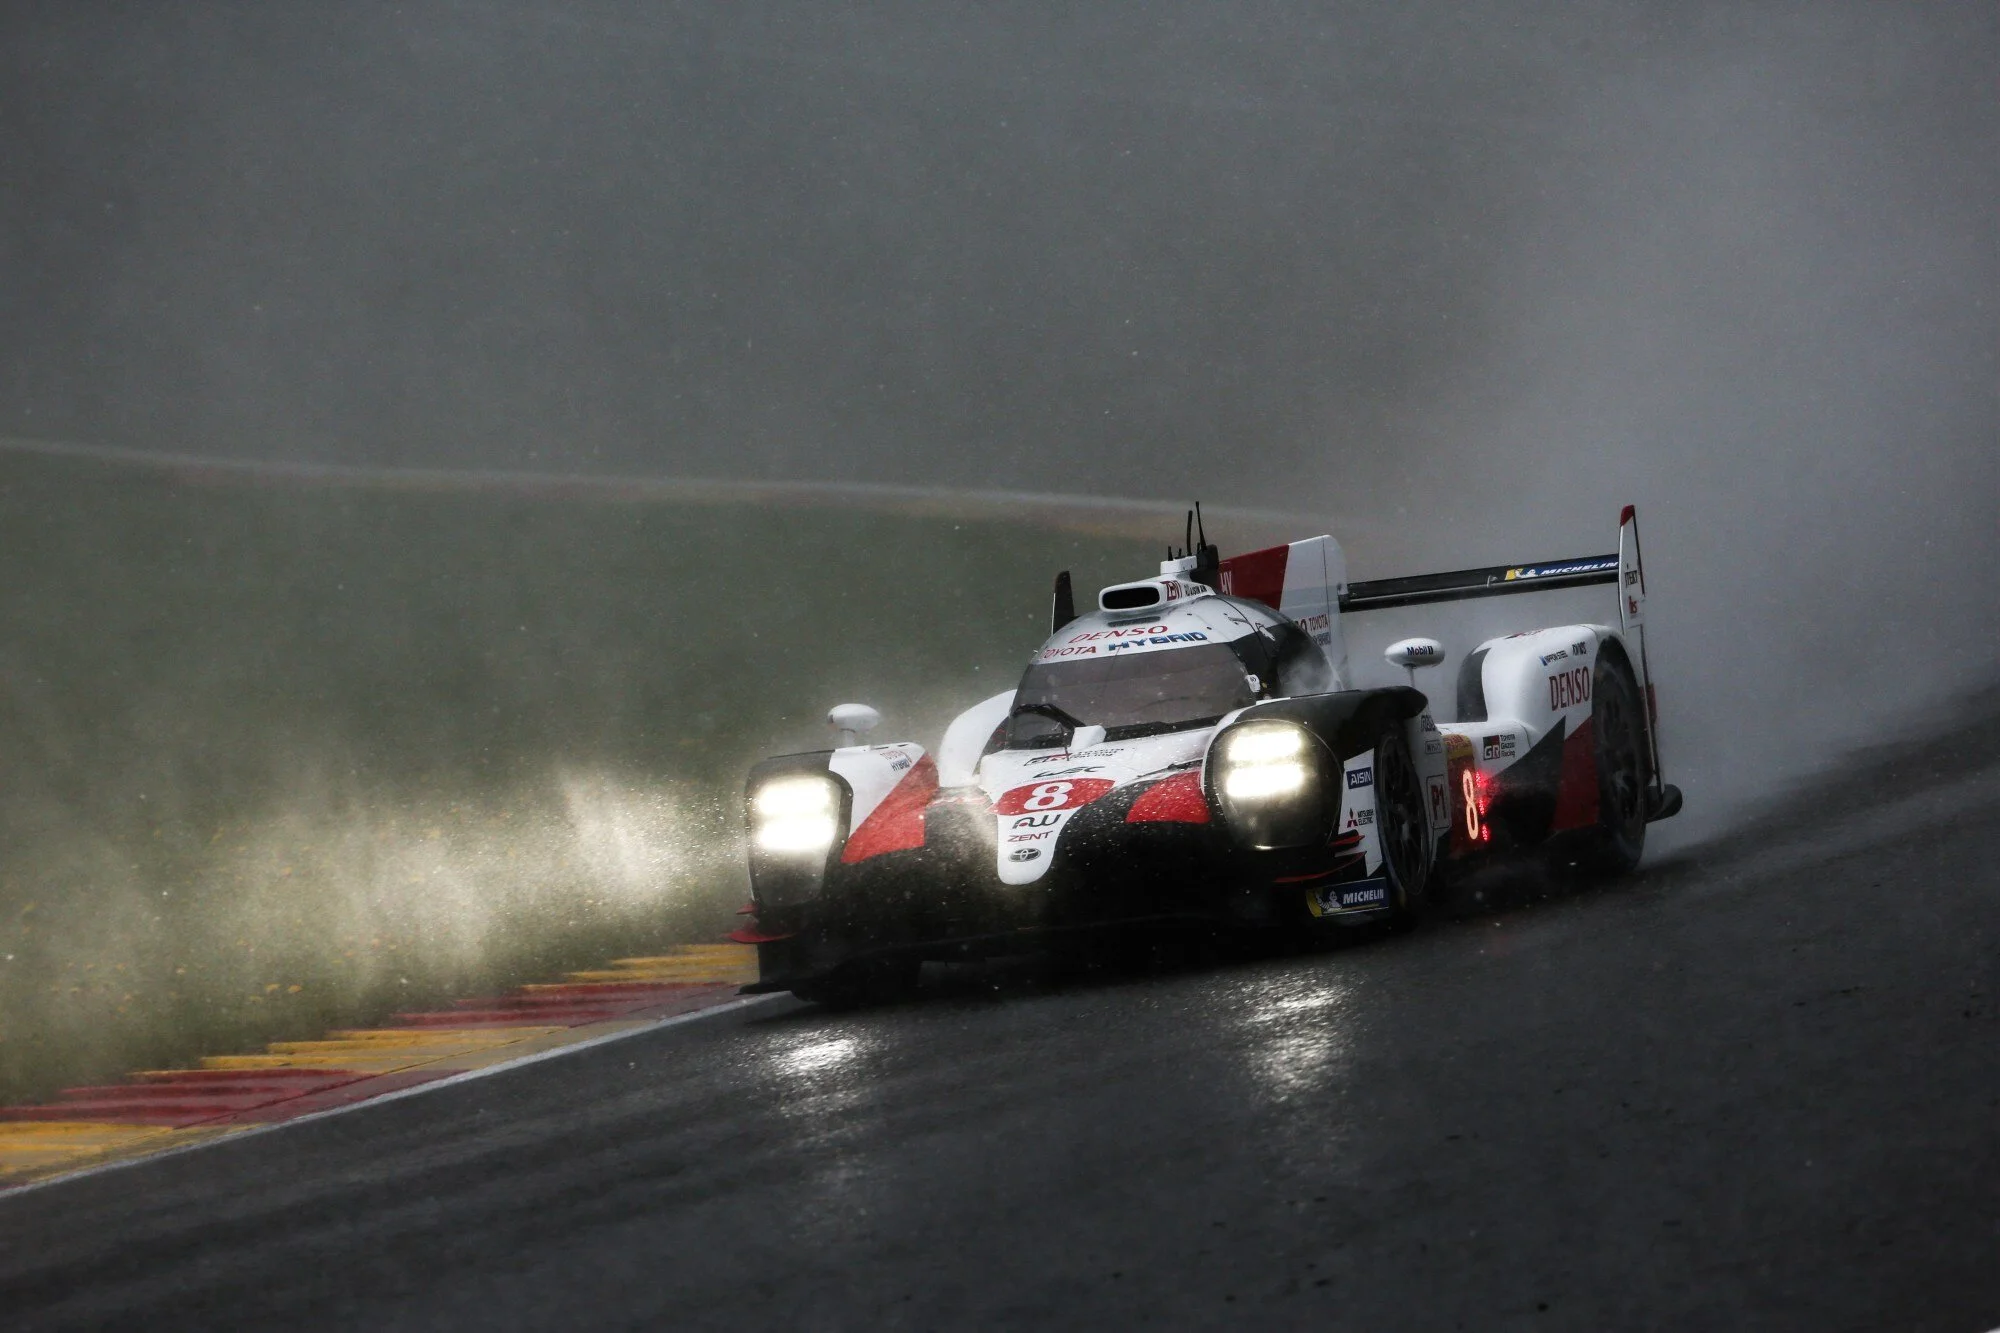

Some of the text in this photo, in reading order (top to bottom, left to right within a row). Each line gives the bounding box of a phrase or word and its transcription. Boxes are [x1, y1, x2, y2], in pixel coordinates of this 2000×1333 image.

[1541, 562, 1619, 576] MICHELIN
[1069, 625, 1169, 644] DENSO
[1044, 631, 1208, 659] TOYOTA HYBRID
[1549, 666, 1590, 711] DENSO
[1485, 744, 1500, 759] GR
[1350, 771, 1371, 786] AISIN
[1023, 781, 1073, 811] 8
[1462, 768, 1479, 840] 8
[1008, 830, 1053, 843] ZENT
[1343, 888, 1384, 905] MICHELIN
